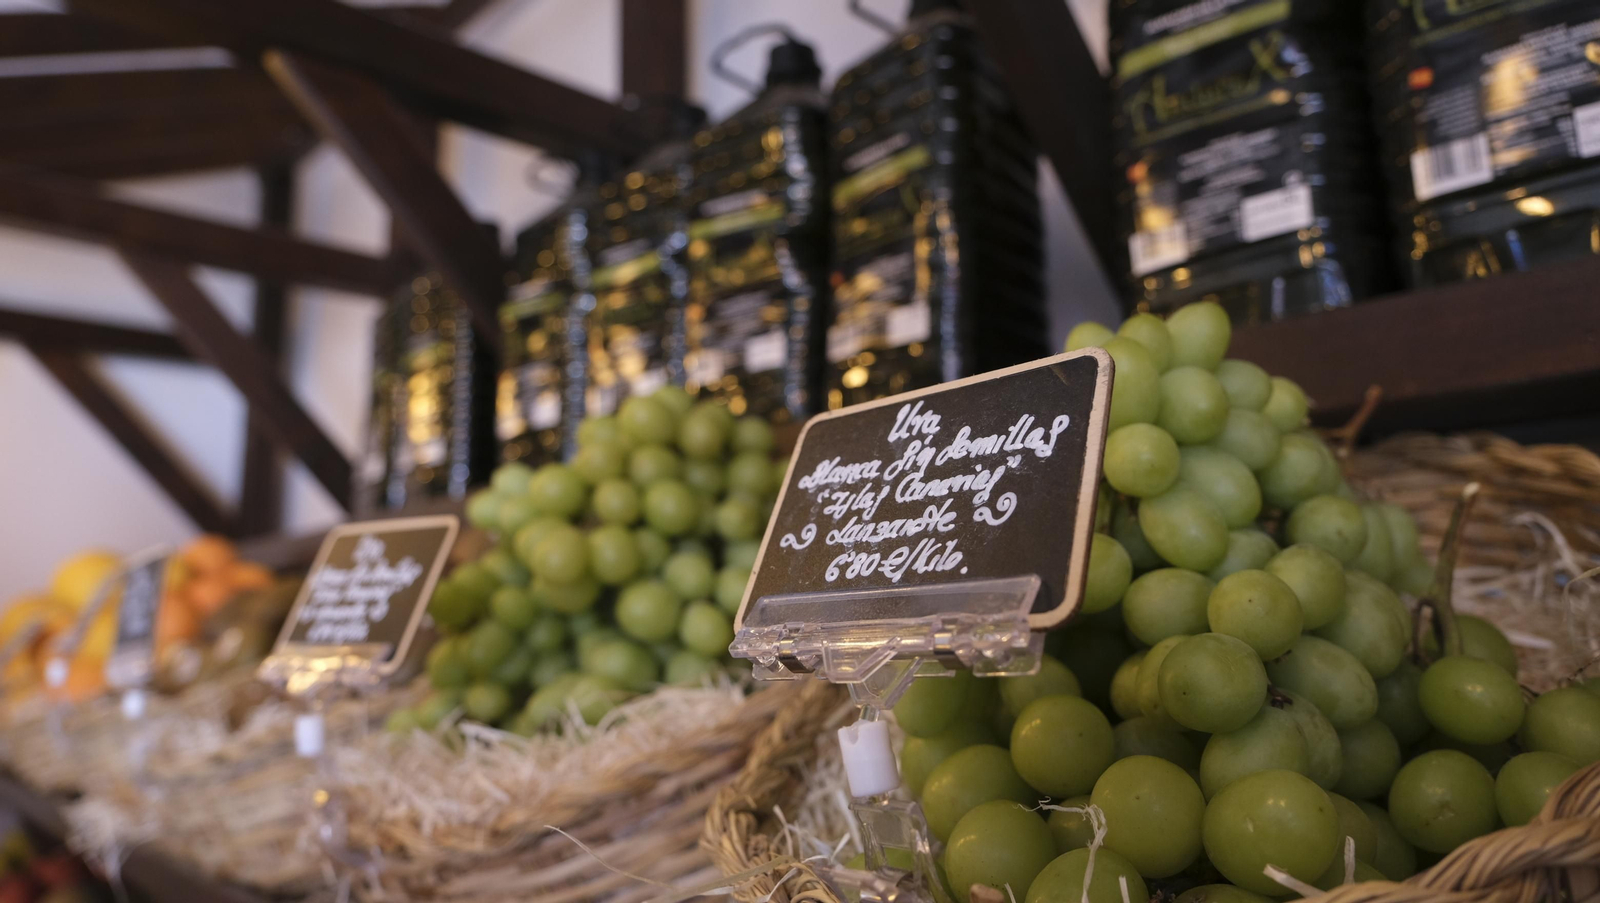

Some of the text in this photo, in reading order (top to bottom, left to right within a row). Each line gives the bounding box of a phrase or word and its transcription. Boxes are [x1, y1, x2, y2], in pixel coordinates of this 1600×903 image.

[887, 400, 942, 443] Uva
[883, 435, 937, 481] Sin
[935, 414, 1070, 466] Semillas
[825, 498, 957, 545] Lanzarote
